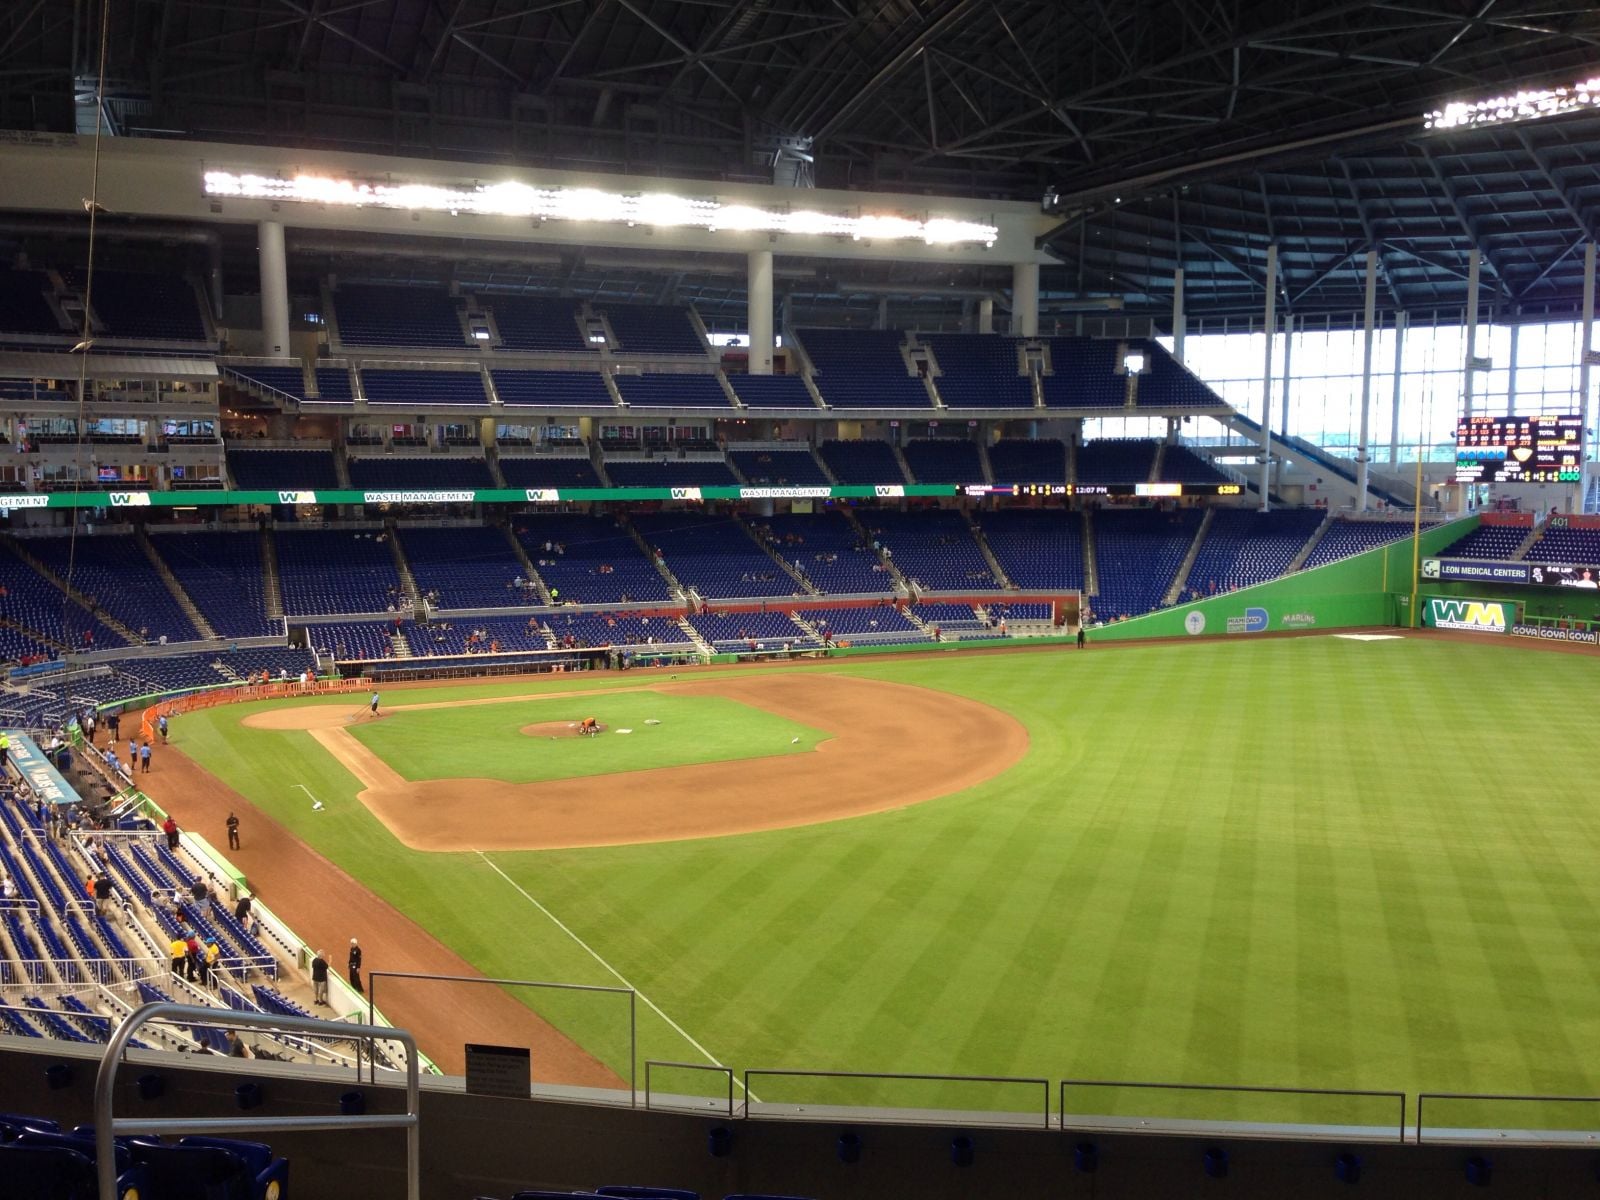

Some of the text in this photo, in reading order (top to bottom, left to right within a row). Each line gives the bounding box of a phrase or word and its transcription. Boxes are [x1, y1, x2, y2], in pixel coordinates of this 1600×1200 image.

[526, 489, 559, 501] WM
[670, 487, 701, 499] WM
[741, 487, 831, 498] WASTE MANAGEMENT
[875, 485, 904, 497] WM
[1075, 486, 1108, 494] 12:07 PM
[110, 493, 151, 505] WM
[279, 491, 316, 503] WM
[365, 492, 475, 503] WASTE MANAGEMENT
[1551, 517, 1568, 527] 401
[1442, 565, 1526, 578] LEON MEDICAL CENTERS
[1282, 613, 1316, 625] MARLINS
[1432, 600, 1505, 627] WM
[1512, 626, 1538, 637] GOYA
[1540, 629, 1566, 640] GOYA
[1568, 631, 1595, 643] GOYA
